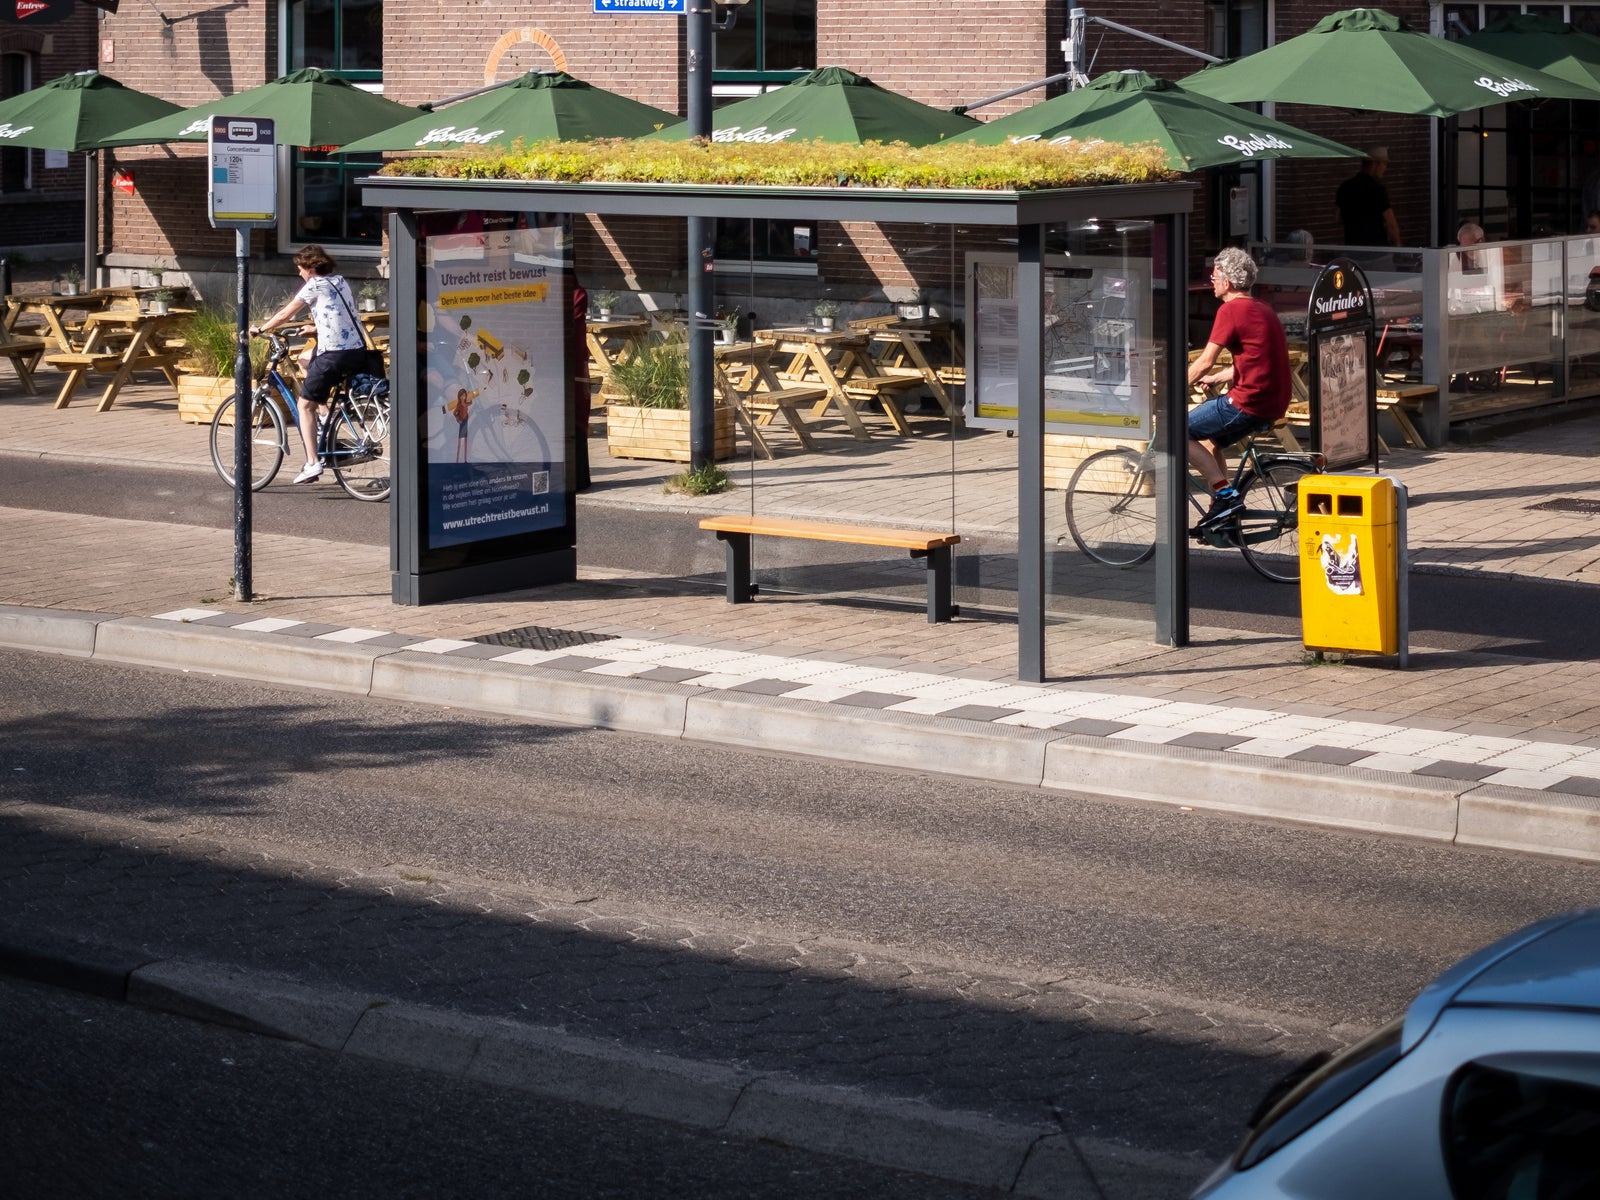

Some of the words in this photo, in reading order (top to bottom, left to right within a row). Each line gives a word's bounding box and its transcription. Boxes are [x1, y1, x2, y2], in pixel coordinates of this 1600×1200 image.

[415, 126, 505, 147] Grolsch
[1217, 132, 1293, 156] Grolsch
[441, 271, 481, 286] Utrecht
[483, 269, 507, 282] reist
[509, 266, 547, 280] bewust
[441, 296, 458, 306] Denk
[491, 292, 503, 301] het
[503, 291, 521, 300] beste
[522, 290, 536, 298] idee
[1315, 291, 1364, 314] Satriale's
[442, 503, 549, 530] www.utrechtreistbewust.nl
